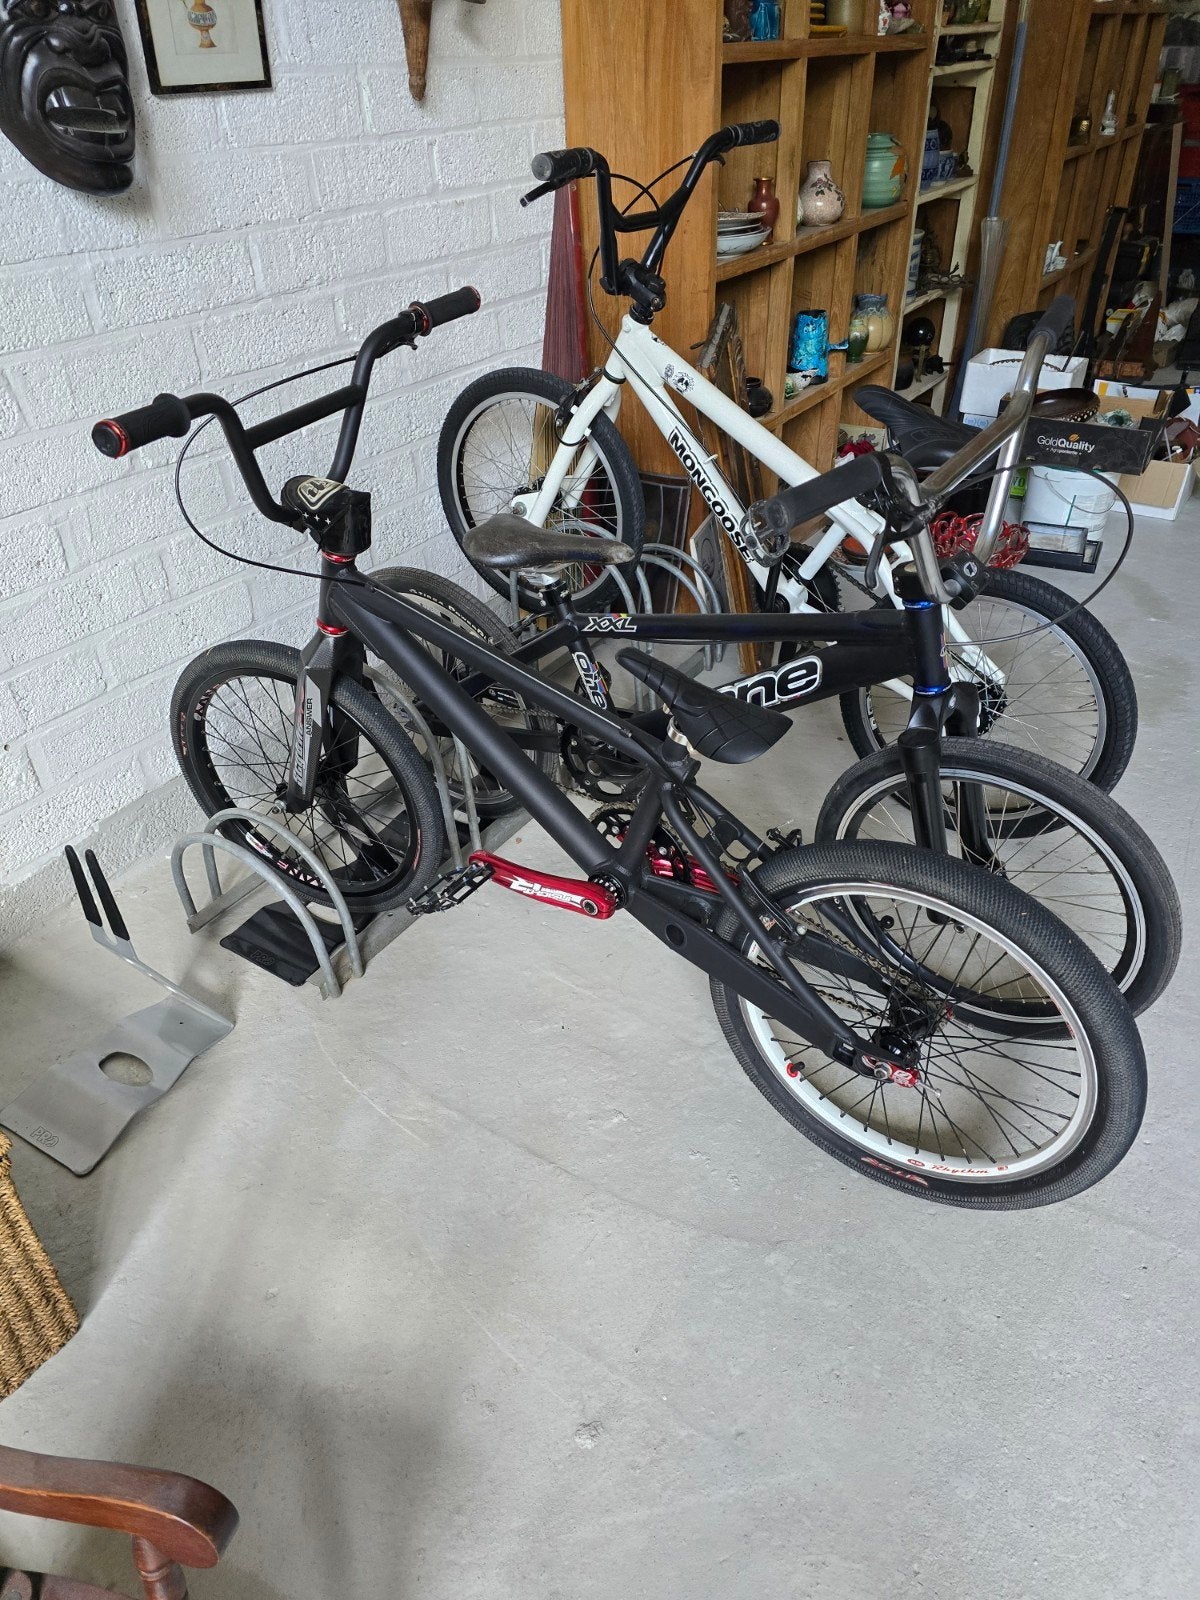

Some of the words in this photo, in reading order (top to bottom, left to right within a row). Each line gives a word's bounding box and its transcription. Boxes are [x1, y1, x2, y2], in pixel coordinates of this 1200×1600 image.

[1037, 435, 1095, 453] GoldQuality
[669, 430, 752, 563] MONGOOSE
[581, 616, 637, 632] XXL
[716, 656, 823, 708] ne
[305, 698, 313, 736] ANSWER
[929, 1163, 990, 1176] Rhythm
